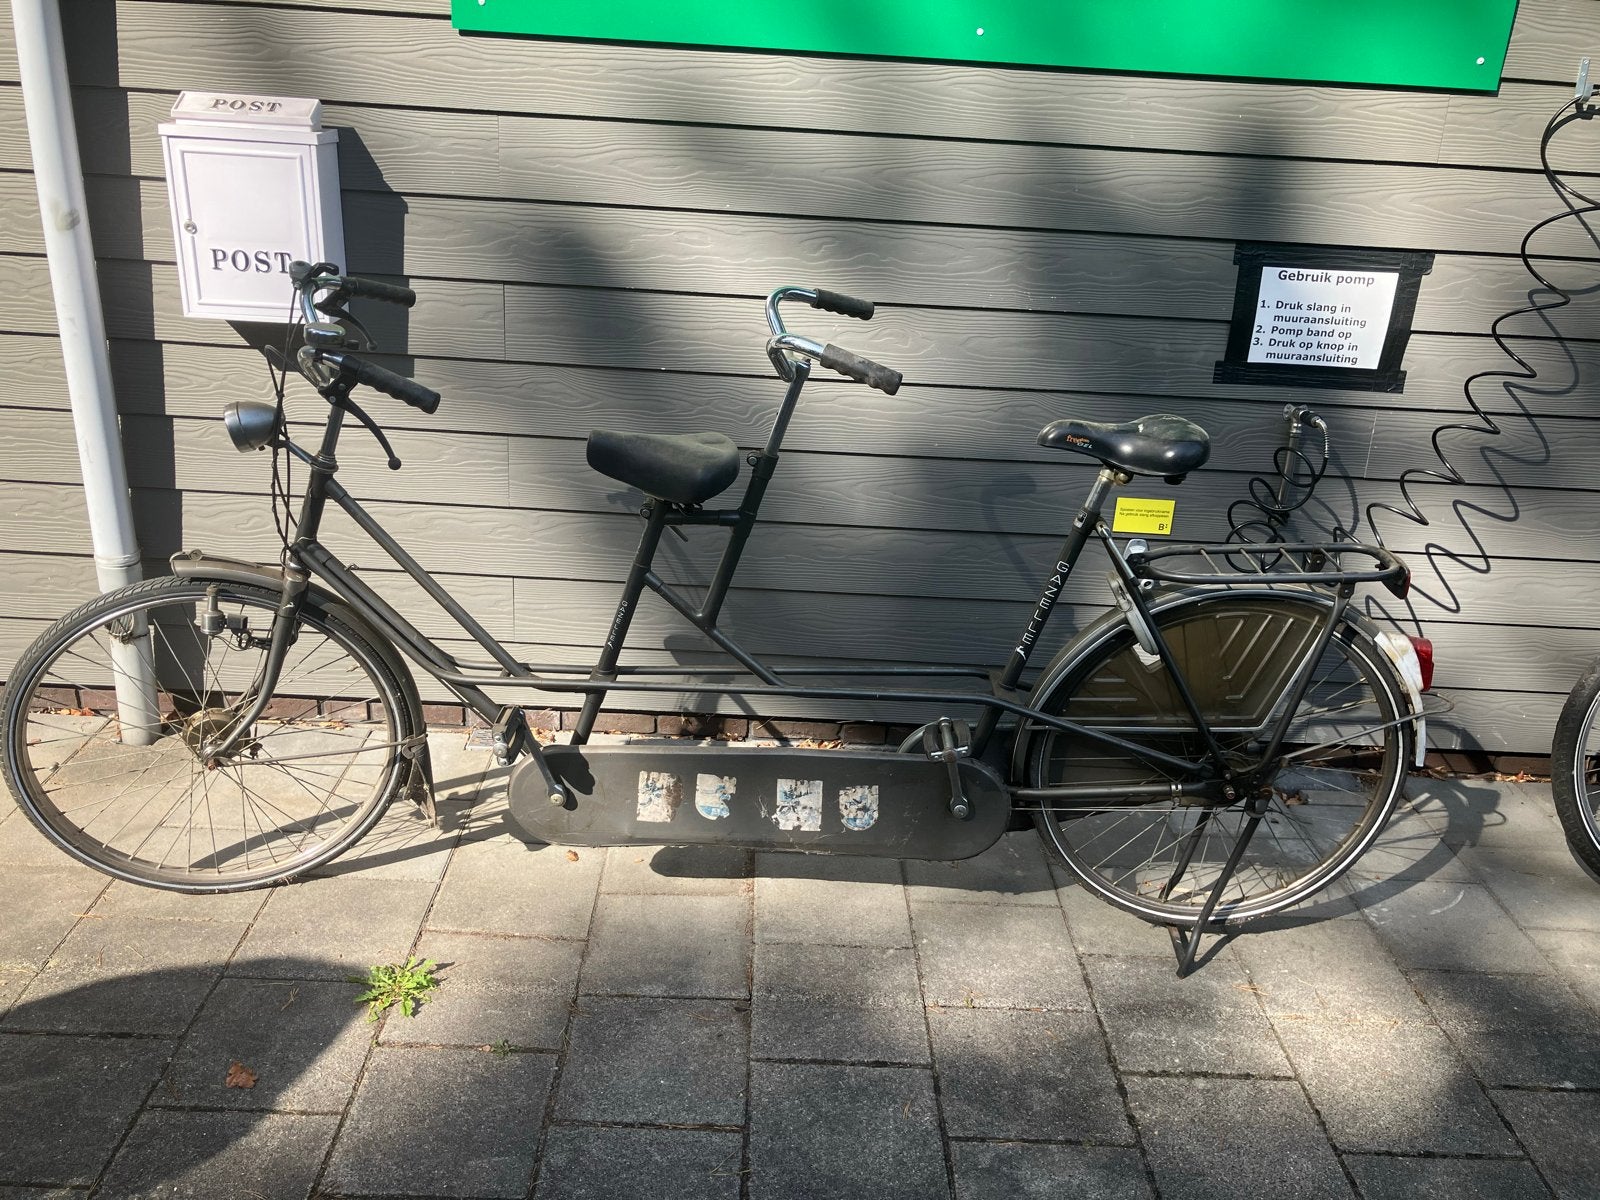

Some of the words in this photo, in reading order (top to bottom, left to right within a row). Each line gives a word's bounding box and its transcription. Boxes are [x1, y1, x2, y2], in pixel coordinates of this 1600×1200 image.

[208, 98, 282, 113] POST
[209, 248, 293, 274] POST
[1277, 270, 1332, 284] Gebruik
[1335, 274, 1376, 288] pomp
[1260, 300, 1270, 309] 1.
[1275, 300, 1303, 311] Druk
[1306, 302, 1337, 314] slang
[1341, 303, 1351, 313] in
[1273, 314, 1367, 329] muuraansluiting
[1255, 325, 1266, 335] 2.
[1271, 326, 1303, 338] Pomp
[1306, 327, 1335, 338] band
[1338, 330, 1352, 340] op
[1252, 337, 1263, 346] 3.
[1268, 338, 1296, 349] Druk
[1299, 341, 1313, 351] op
[1316, 341, 1345, 352] knop
[1348, 342, 1358, 352] in
[1265, 351, 1358, 366] muuraansluiting
[1022, 560, 1070, 645] GAZELLE
